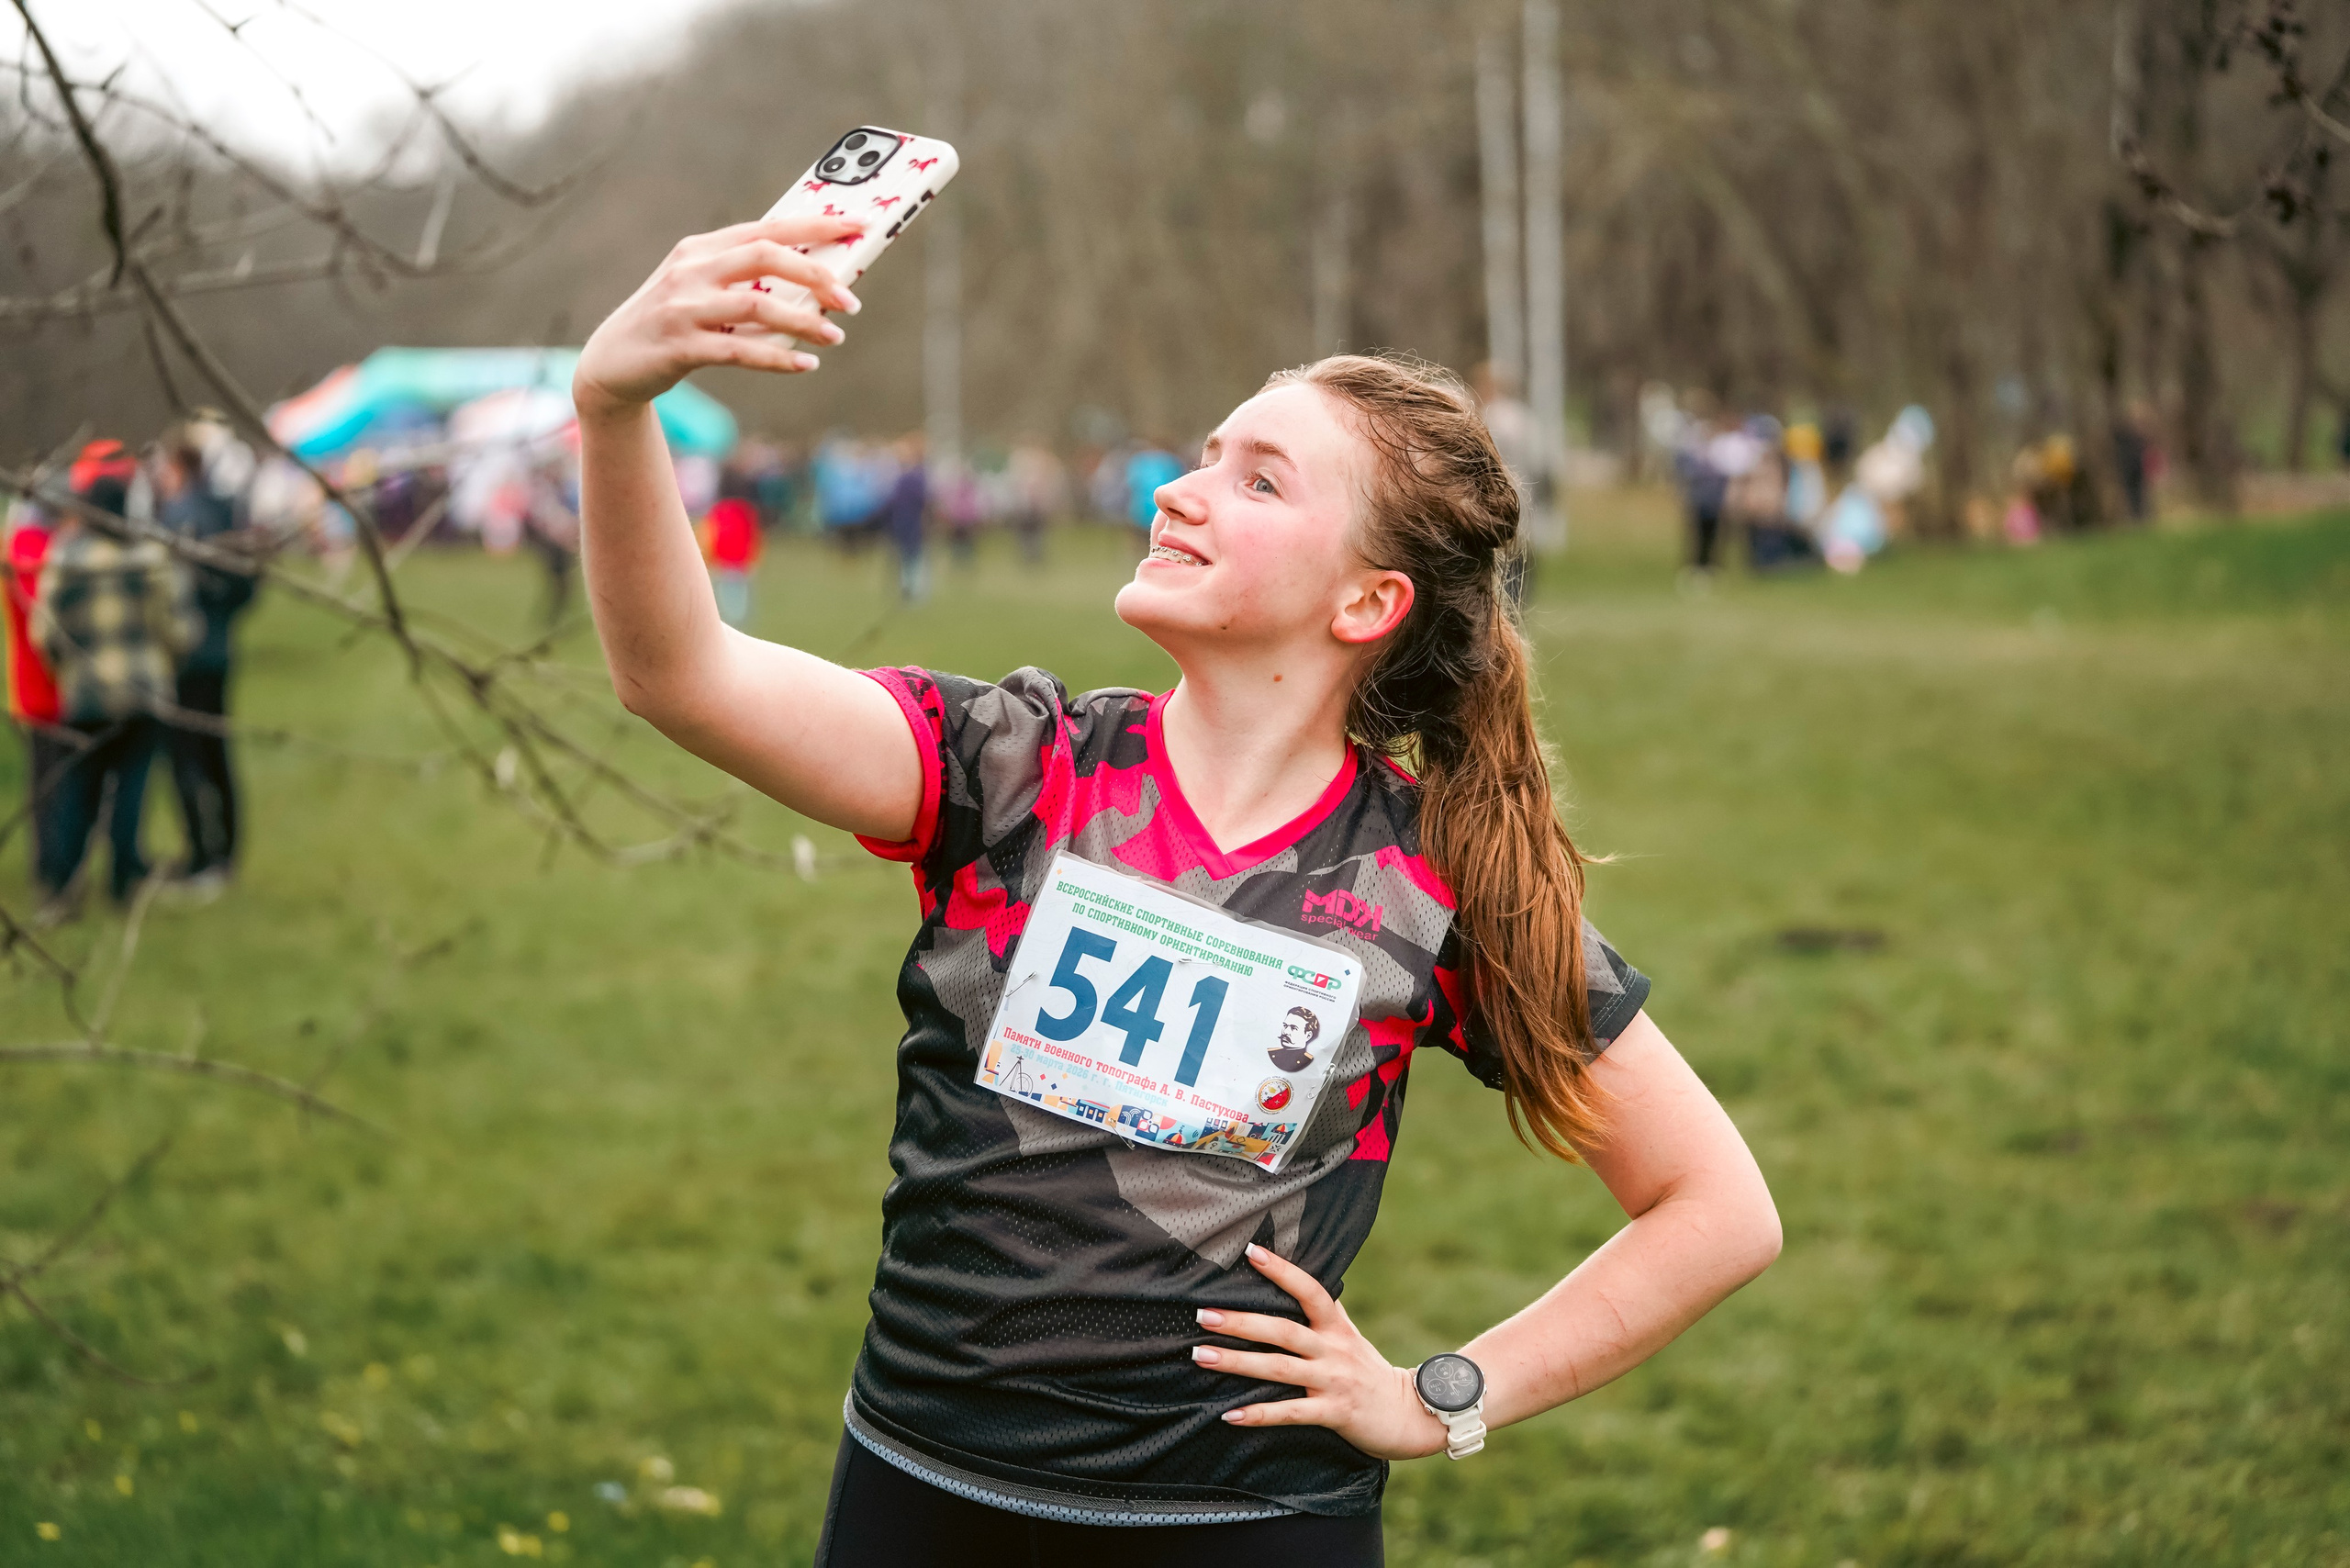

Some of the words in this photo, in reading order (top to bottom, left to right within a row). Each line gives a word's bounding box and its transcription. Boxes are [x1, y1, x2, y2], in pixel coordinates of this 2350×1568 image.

[1057, 881, 1134, 915] ВСЕРОССИЙСКИЕ
[1136, 909, 1203, 942] СПОРТИВНЫЕ
[1206, 935, 1282, 969] СОРЕВНОВАНИЯ
[1072, 903, 1085, 914] ПО
[1087, 908, 1158, 940] СПОРТИВНОМУ
[1159, 935, 1253, 976] ОРИЕНТИРОВАНИЮ
[1301, 913, 1346, 929] special
[1348, 926, 1378, 941] wear
[1035, 926, 1229, 1087] 541
[1003, 1027, 1041, 1049] Памяти
[1044, 1044, 1092, 1067] военного
[1097, 1062, 1156, 1090] топографа
[1159, 1084, 1169, 1095] А.
[1175, 1090, 1185, 1101] В.
[1191, 1095, 1248, 1123] Пастухова
[1010, 1044, 1035, 1059] 25-30
[1036, 1055, 1064, 1070] марта
[1066, 1064, 1090, 1079] 2026
